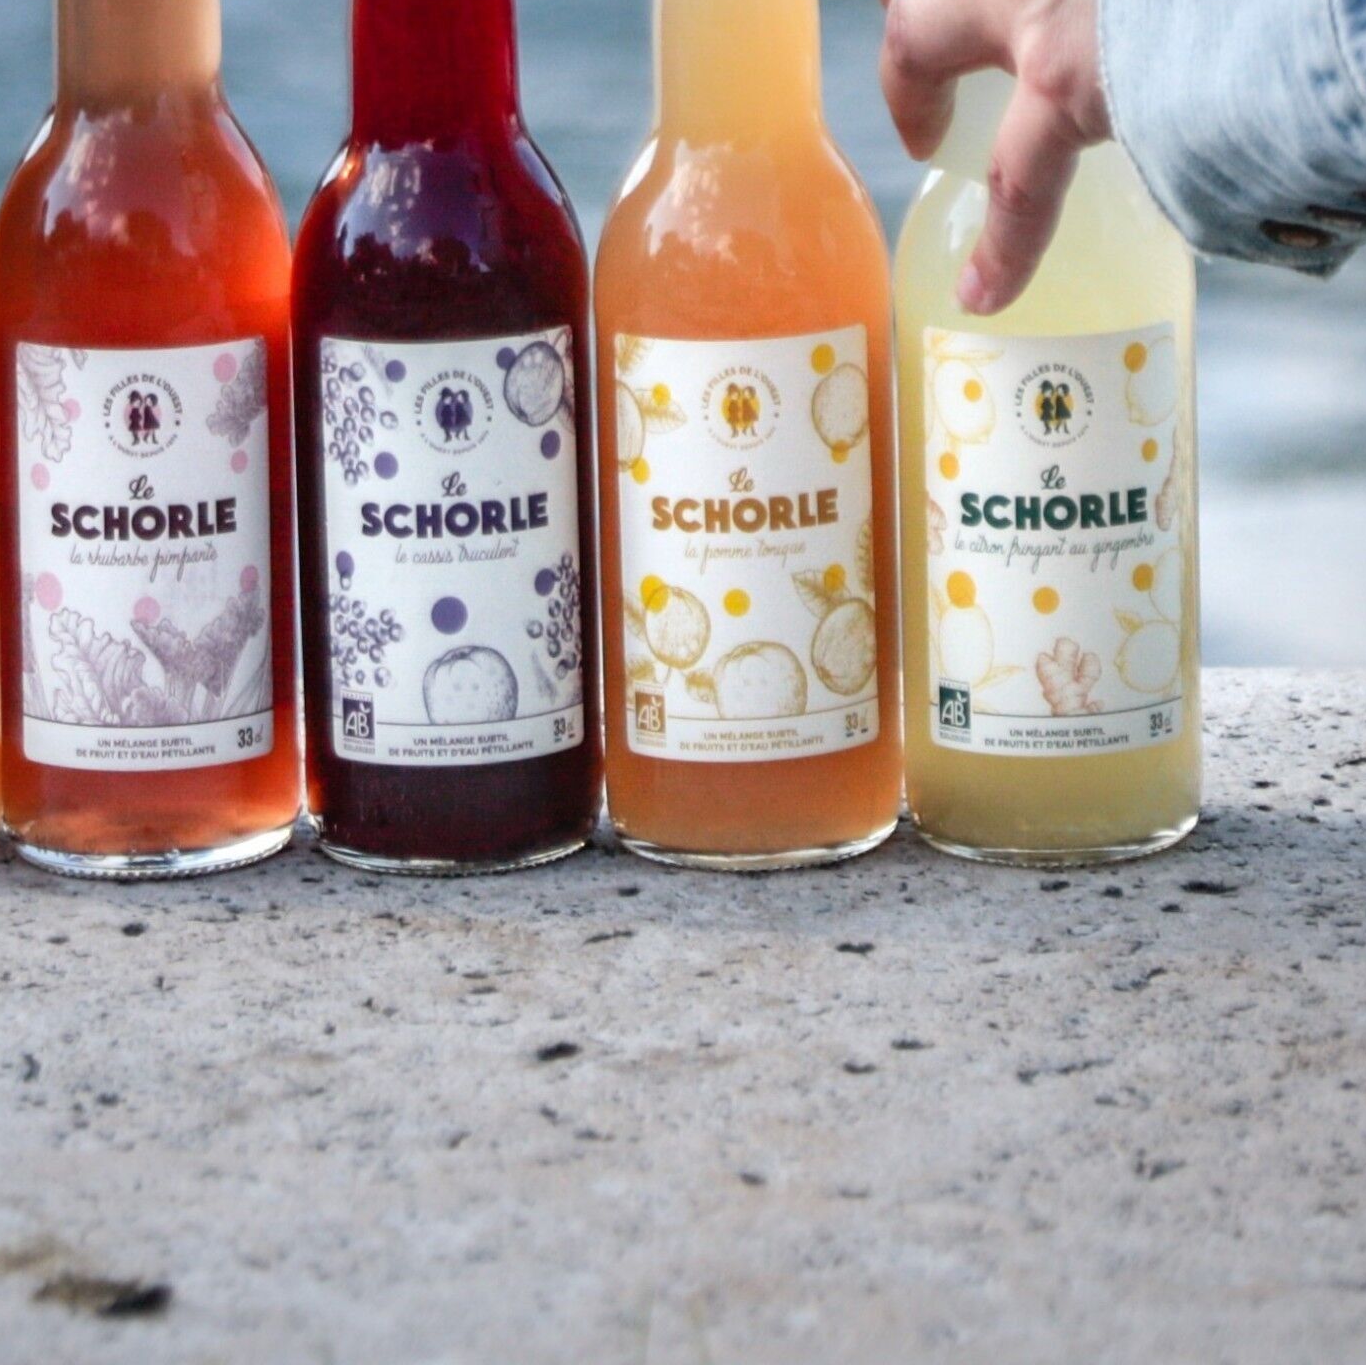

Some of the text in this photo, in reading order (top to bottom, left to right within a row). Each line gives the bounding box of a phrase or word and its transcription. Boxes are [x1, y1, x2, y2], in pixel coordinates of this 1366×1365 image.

[128, 474, 155, 501] Le
[440, 472, 466, 498] Le
[728, 467, 755, 493] Le
[1040, 465, 1066, 491] Le
[50, 497, 237, 542] SCHORLE
[361, 492, 548, 538] SCHORLE
[651, 489, 839, 534] SCHORLE
[960, 487, 1148, 531] SCHORLE
[70, 540, 218, 583] la rhubarbe pimpante
[395, 538, 519, 565] le cassis truculent
[954, 529, 1155, 573] le citron fringant au gingembre
[553, 718, 566, 736] 33
[845, 712, 858, 730] 33
[1150, 713, 1163, 731] 33
[238, 728, 253, 748] 33
